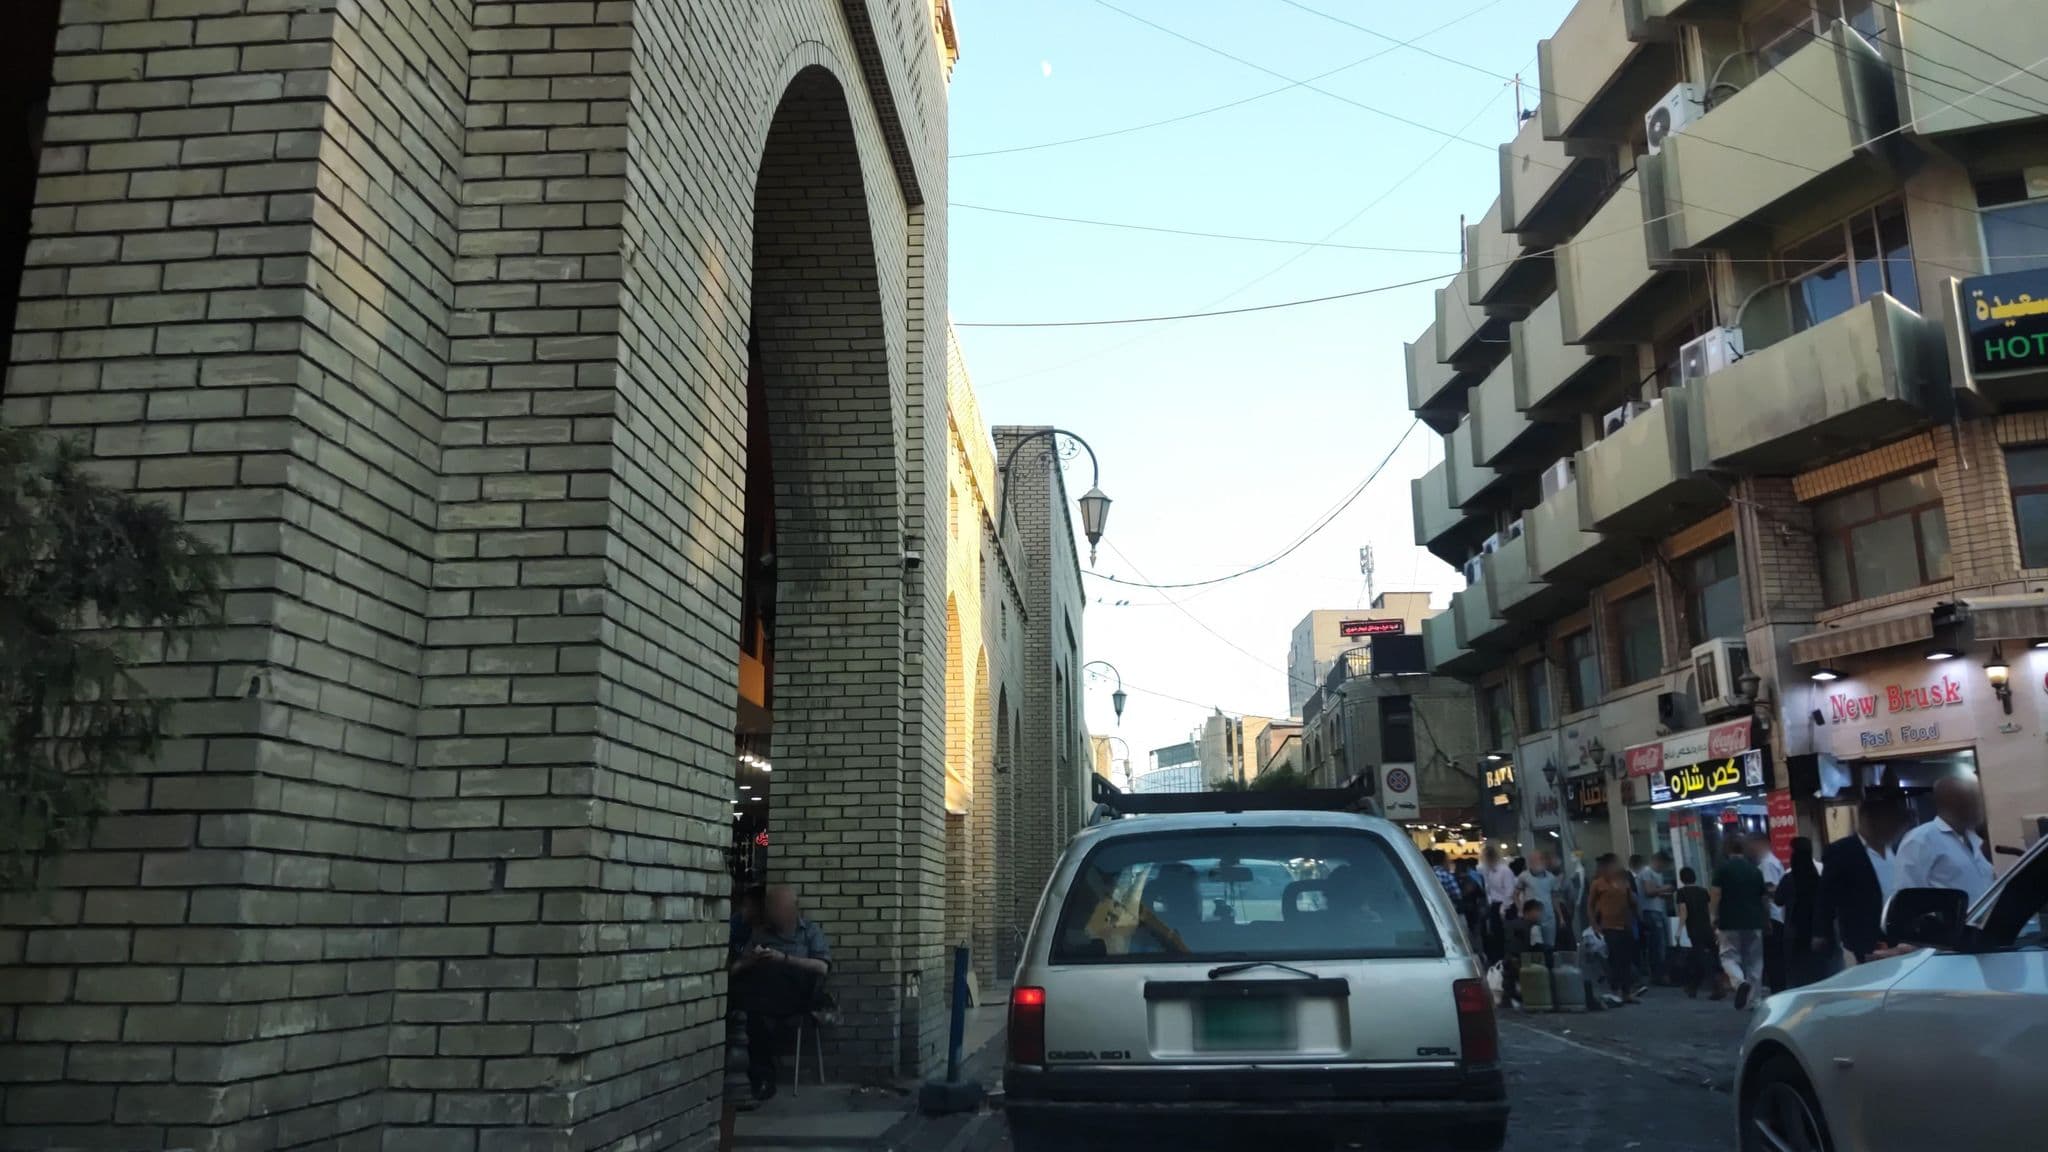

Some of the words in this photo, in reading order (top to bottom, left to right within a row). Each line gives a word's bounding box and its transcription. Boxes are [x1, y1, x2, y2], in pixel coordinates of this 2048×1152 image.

[1830, 694, 1877, 723] New
[1886, 675, 1963, 713] Brusk
[1860, 728, 1893, 748] Fast
[1900, 722, 1940, 742] Food
